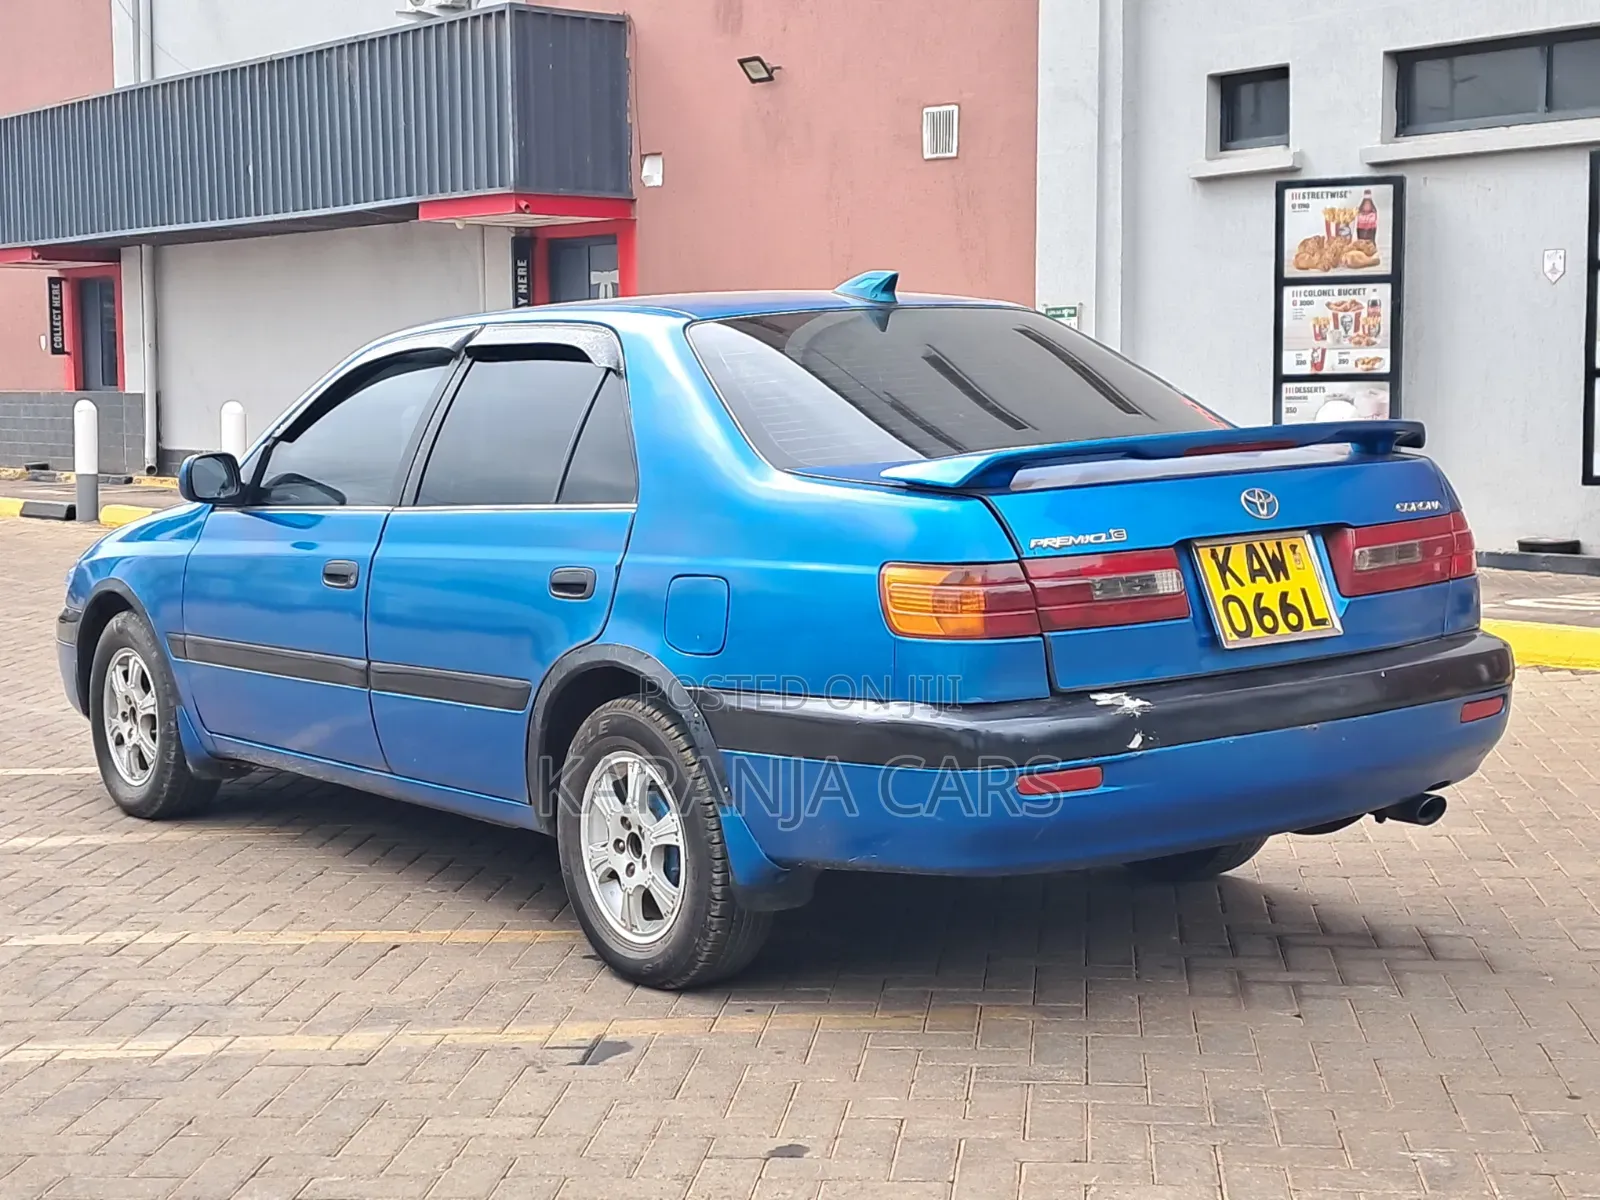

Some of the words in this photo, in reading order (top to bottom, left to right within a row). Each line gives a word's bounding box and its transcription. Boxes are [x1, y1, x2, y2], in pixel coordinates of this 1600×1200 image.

[1302, 190, 1348, 200] STREETWISE
[517, 259, 528, 293] HERE
[51, 283, 60, 307] HERE
[1303, 290, 1335, 298] COLONEL
[1338, 287, 1367, 296] BUCKET
[52, 309, 62, 348] COLLECT
[1295, 386, 1326, 394] DESSERTS
[1030, 533, 1106, 549] PREMIO
[1210, 541, 1290, 591] KAW
[1222, 587, 1329, 639] 066L
